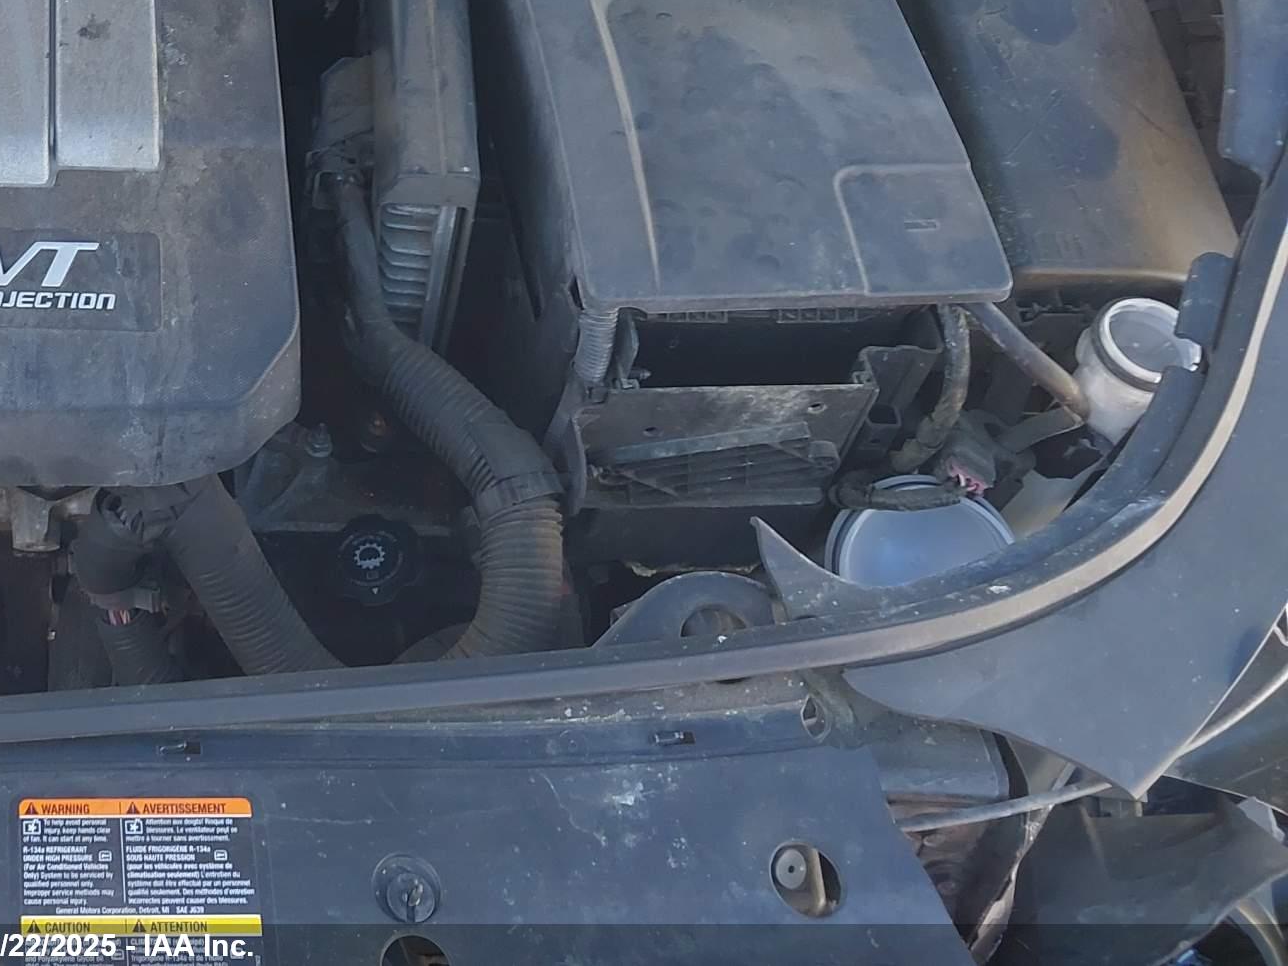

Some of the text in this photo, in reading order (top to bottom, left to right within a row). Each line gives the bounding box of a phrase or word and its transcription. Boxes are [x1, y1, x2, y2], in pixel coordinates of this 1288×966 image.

[41, 802, 90, 815] WARNING
[143, 802, 227, 814] AVERTISSEMENT
[45, 922, 90, 933] CAUTION
[150, 921, 207, 932] ATTENTION
